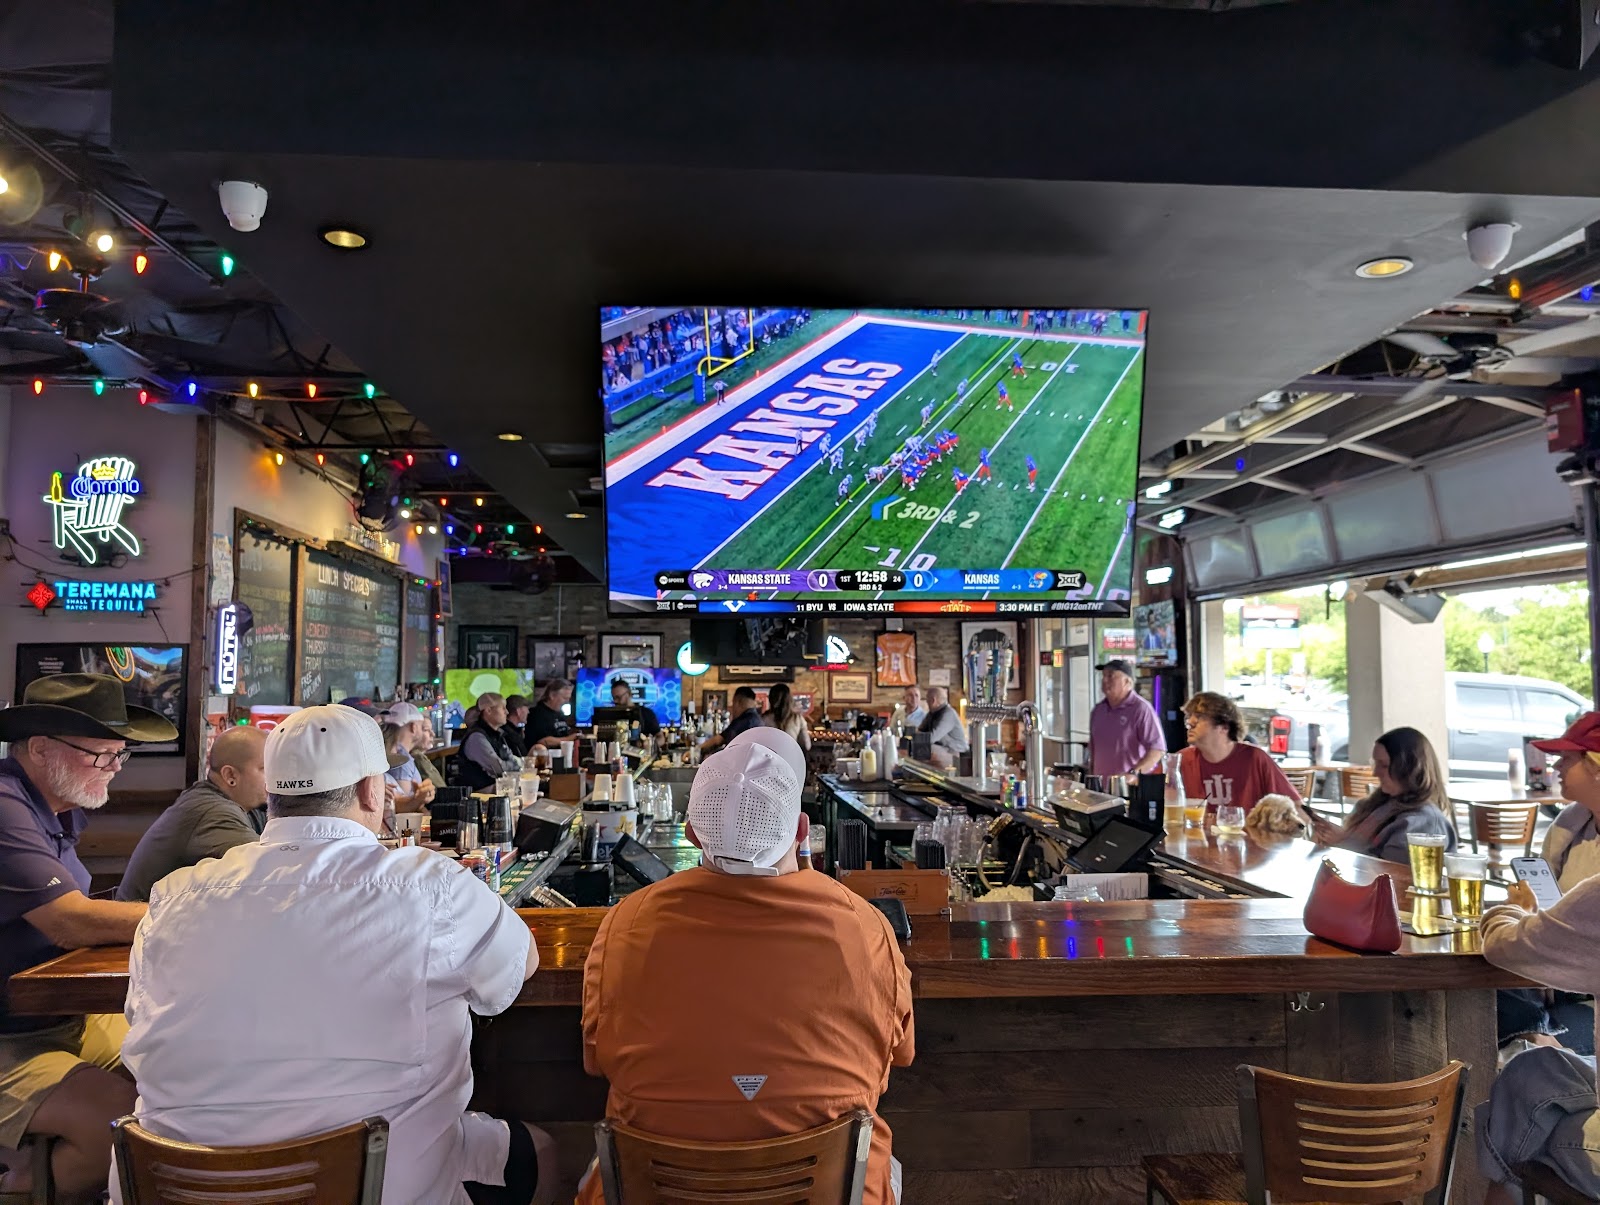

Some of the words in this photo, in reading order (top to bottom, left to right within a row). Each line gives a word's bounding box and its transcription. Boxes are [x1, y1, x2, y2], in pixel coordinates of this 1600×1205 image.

[643, 358, 903, 501] KANSAS
[71, 477, 140, 499] Corona
[897, 502, 941, 523] 3RD
[941, 511, 957, 524] &
[959, 511, 981, 529] 2
[878, 547, 938, 570] 10
[318, 563, 339, 587] LUNCH
[343, 570, 370, 597] SPECIALS
[728, 574, 763, 584] KANSAS
[764, 574, 791, 584] STATE
[819, 573, 828, 587] 0
[854, 571, 888, 582] 12:58
[913, 573, 923, 587] 0
[964, 574, 1000, 584] KANSAS
[54, 582, 156, 599] TEREMANA
[91, 599, 144, 611] TEQUILA
[806, 603, 824, 611] BYU
[828, 603, 837, 611] VS
[844, 603, 866, 611] IOWA
[867, 603, 895, 611] STATE
[999, 603, 1017, 611] 3:30
[1018, 603, 1032, 611] PM
[1033, 603, 1044, 611] ET
[1051, 602, 1104, 610] #BIG12onTNT
[276, 779, 314, 789] HAWKS
